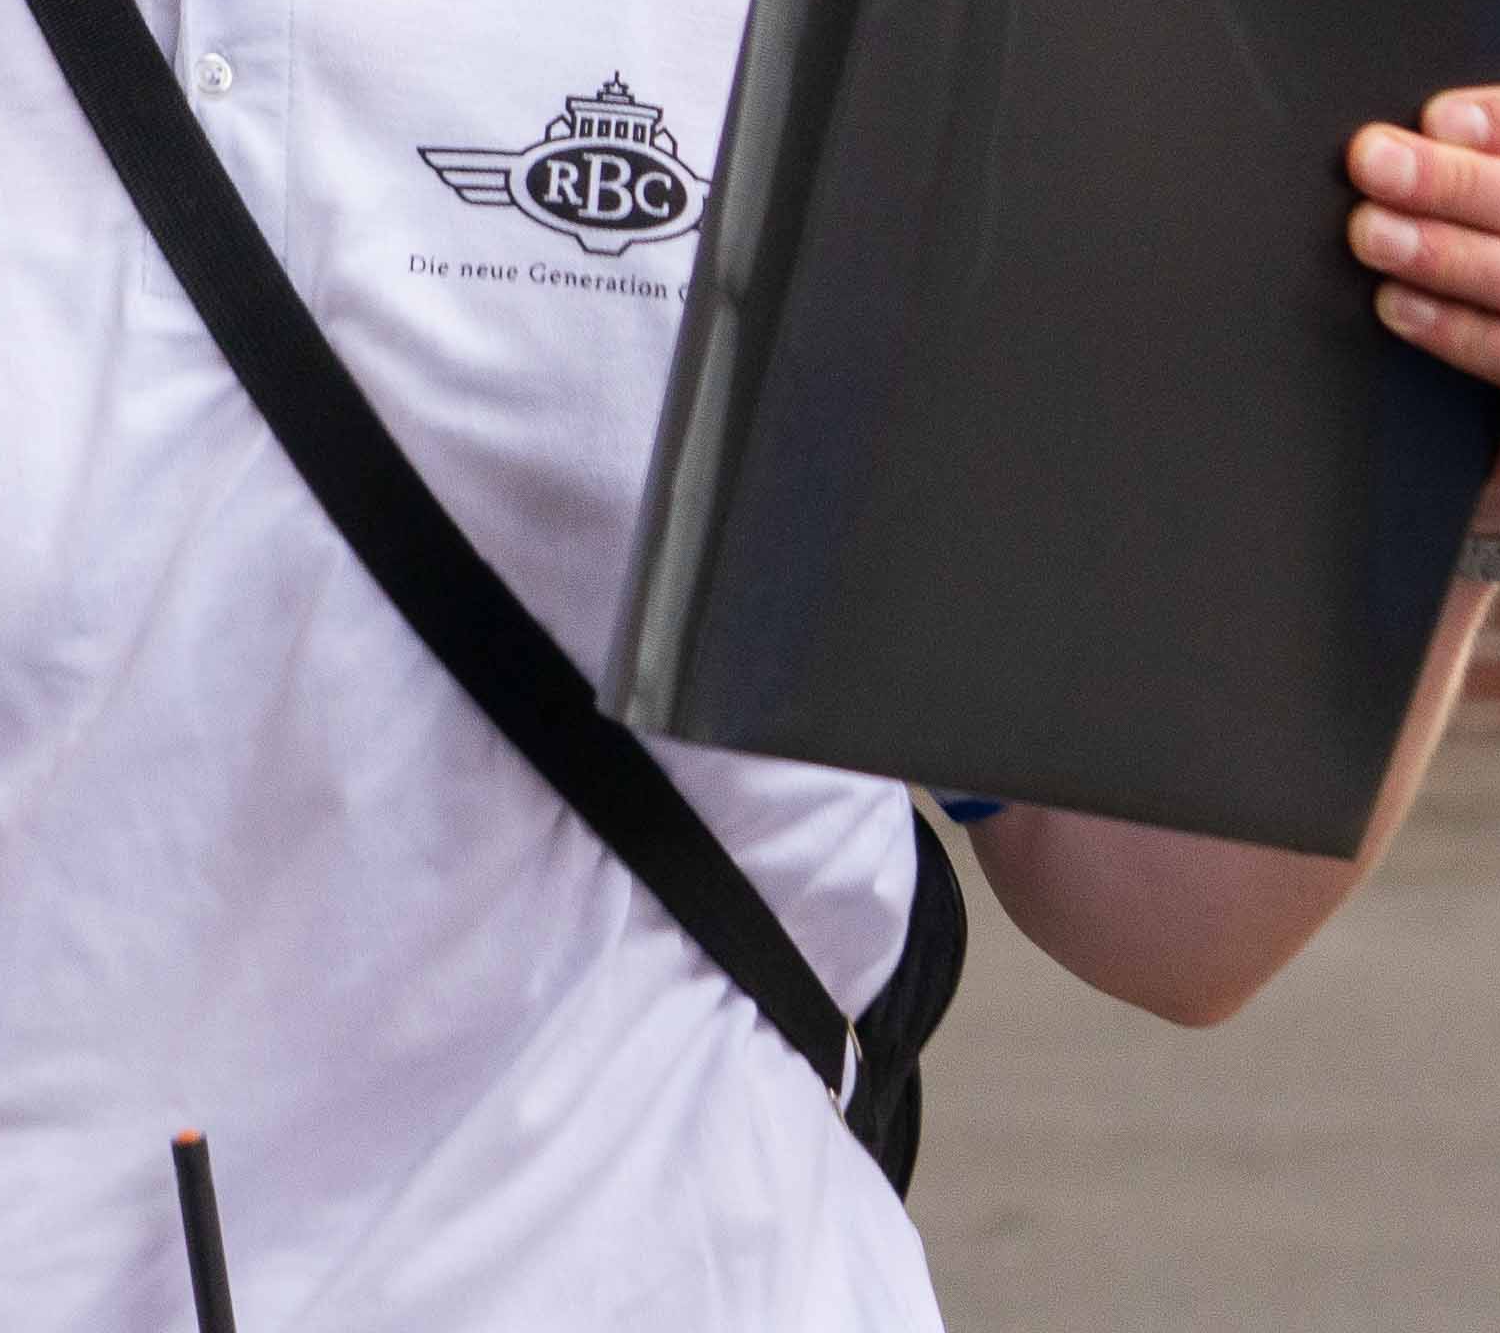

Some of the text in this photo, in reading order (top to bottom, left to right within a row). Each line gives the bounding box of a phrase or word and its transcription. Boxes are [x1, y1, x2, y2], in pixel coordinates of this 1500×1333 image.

[544, 152, 673, 222] RBC
[408, 253, 450, 278] Die
[460, 262, 520, 281] neue
[529, 261, 669, 300] Generation
